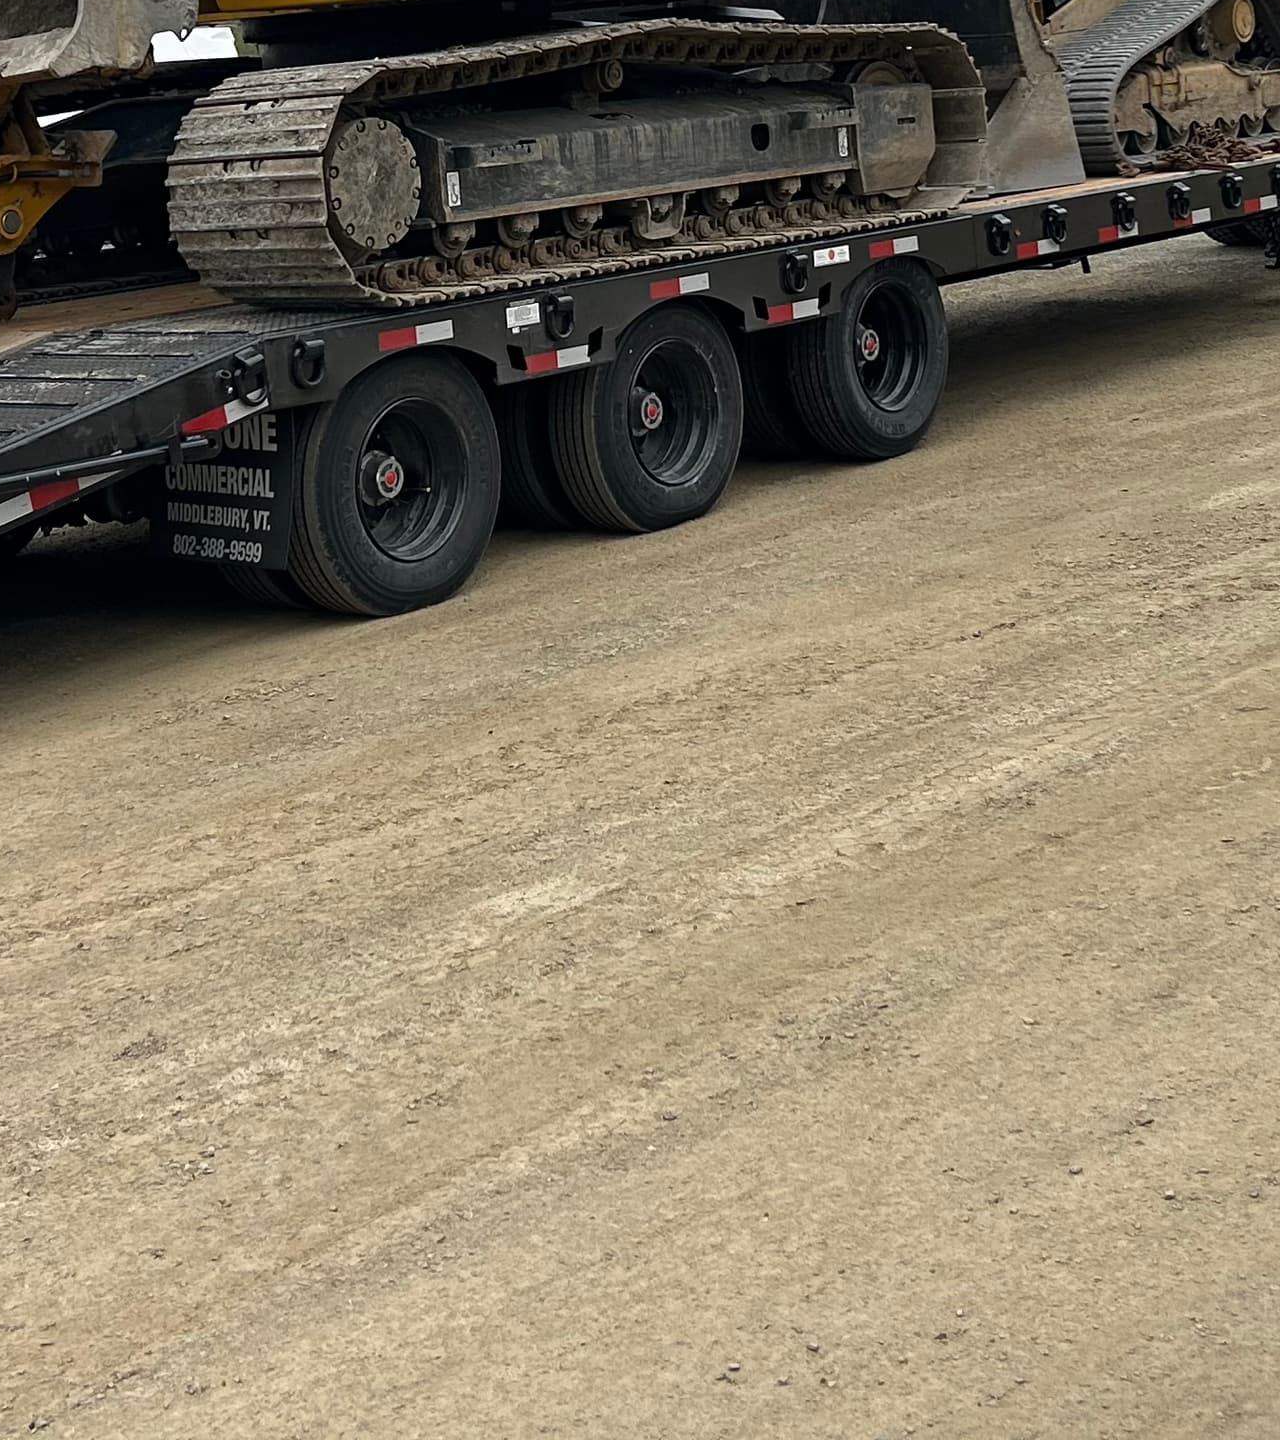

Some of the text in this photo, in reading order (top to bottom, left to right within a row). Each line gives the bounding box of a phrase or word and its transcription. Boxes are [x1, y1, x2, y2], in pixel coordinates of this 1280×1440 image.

[165, 463, 275, 498] COMMERCIAL
[167, 502, 271, 533] MIDDLEBURY, VT.
[173, 534, 263, 563] 802-388-9599
